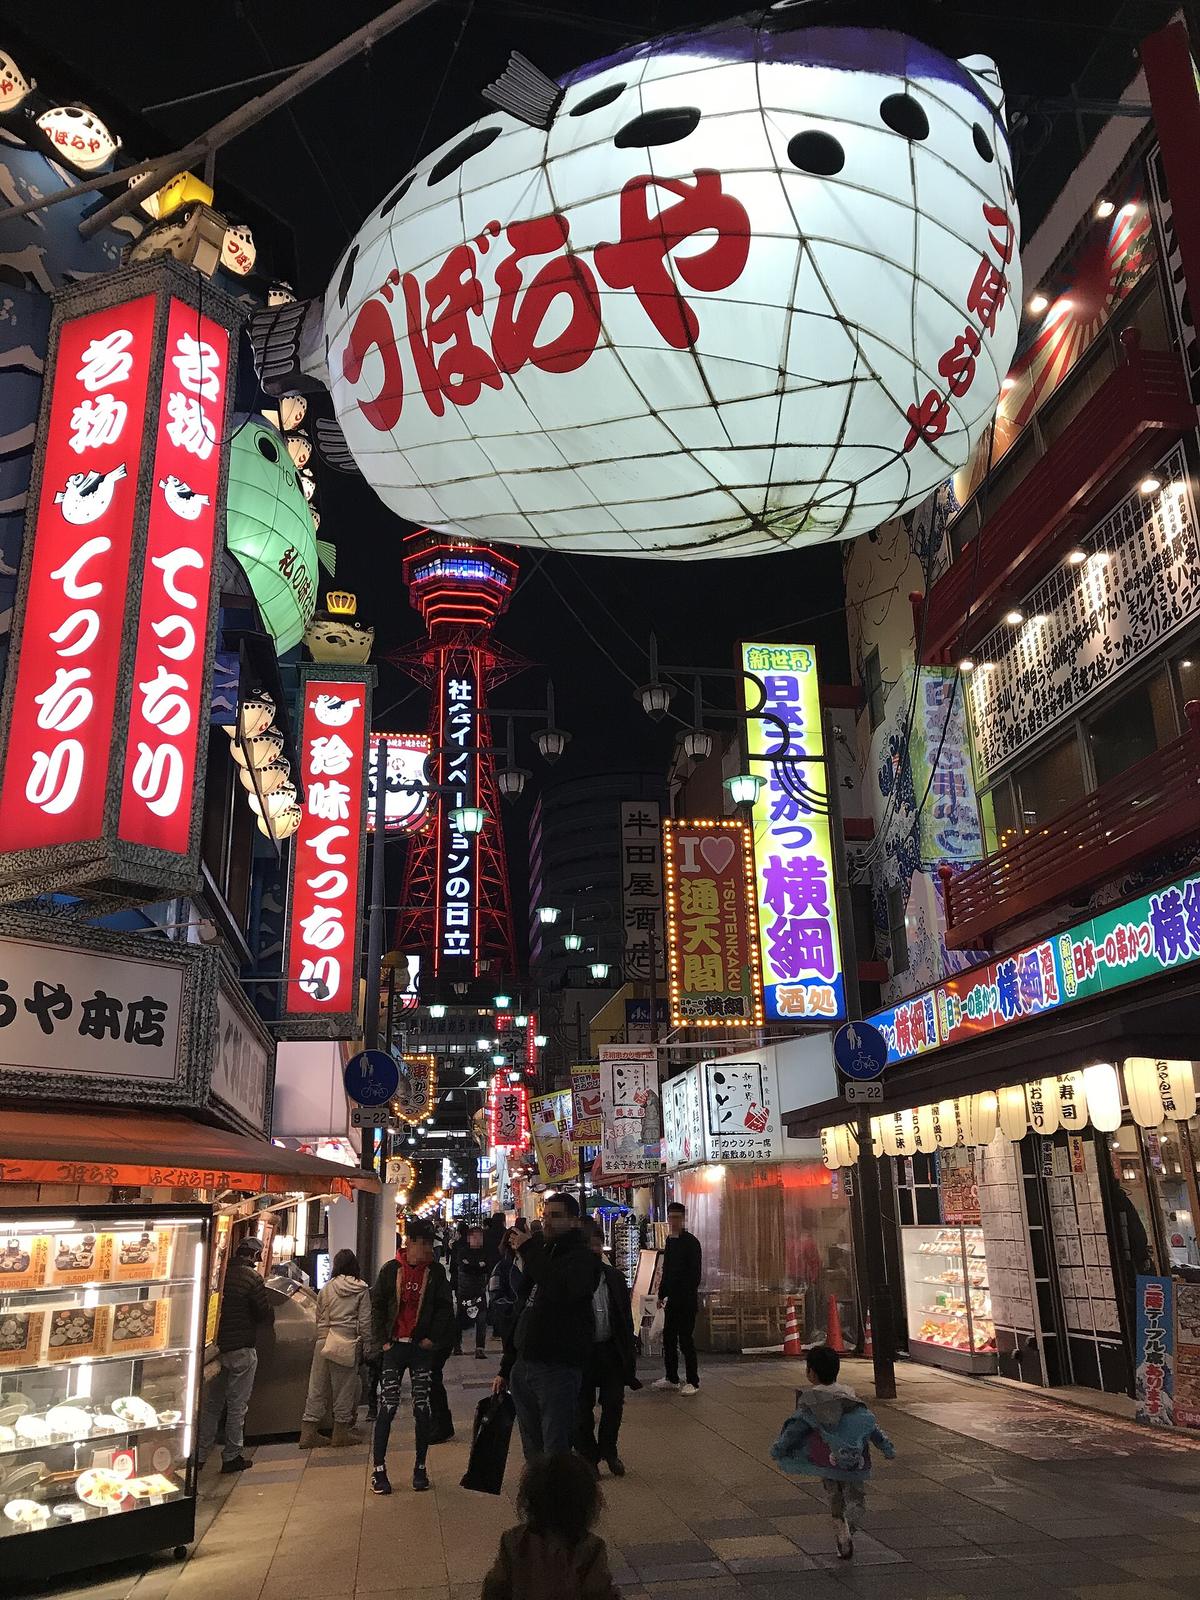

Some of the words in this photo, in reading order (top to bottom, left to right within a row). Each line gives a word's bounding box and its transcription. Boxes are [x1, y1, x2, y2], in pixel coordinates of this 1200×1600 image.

[343, 169, 751, 431] づぼらや
[748, 647, 811, 672] 新世界
[762, 675, 813, 848] 日本一の串かつ
[443, 679, 472, 955] 社会イノベーョンの日立
[679, 836, 701, 872] I
[680, 877, 725, 993] 通天閣
[722, 878, 741, 992] TSUTENKAKU
[762, 855, 838, 982] 横綱
[1073, 922, 1151, 979] 日本一の串かつ
[996, 946, 1046, 1020] 横綱
[1039, 940, 1060, 1005] 酒処
[704, 996, 745, 1016] 横綱
[779, 989, 835, 1016] 酒処
[894, 999, 927, 1057] 横綱
[503, 1094, 520, 1130] 串かつ
[1029, 1088, 1044, 1128] お造り
[1059, 1083, 1077, 1121] 寿司
[721, 1138, 772, 1149] カウンター席
[721, 1149, 772, 1160] 座敷あります
[150, 1168, 242, 1188] ふぐなら日本一
[604, 1160, 660, 1170] 宴会予約受付中
[1143, 1283, 1166, 1416] 二階テーブル席あります
